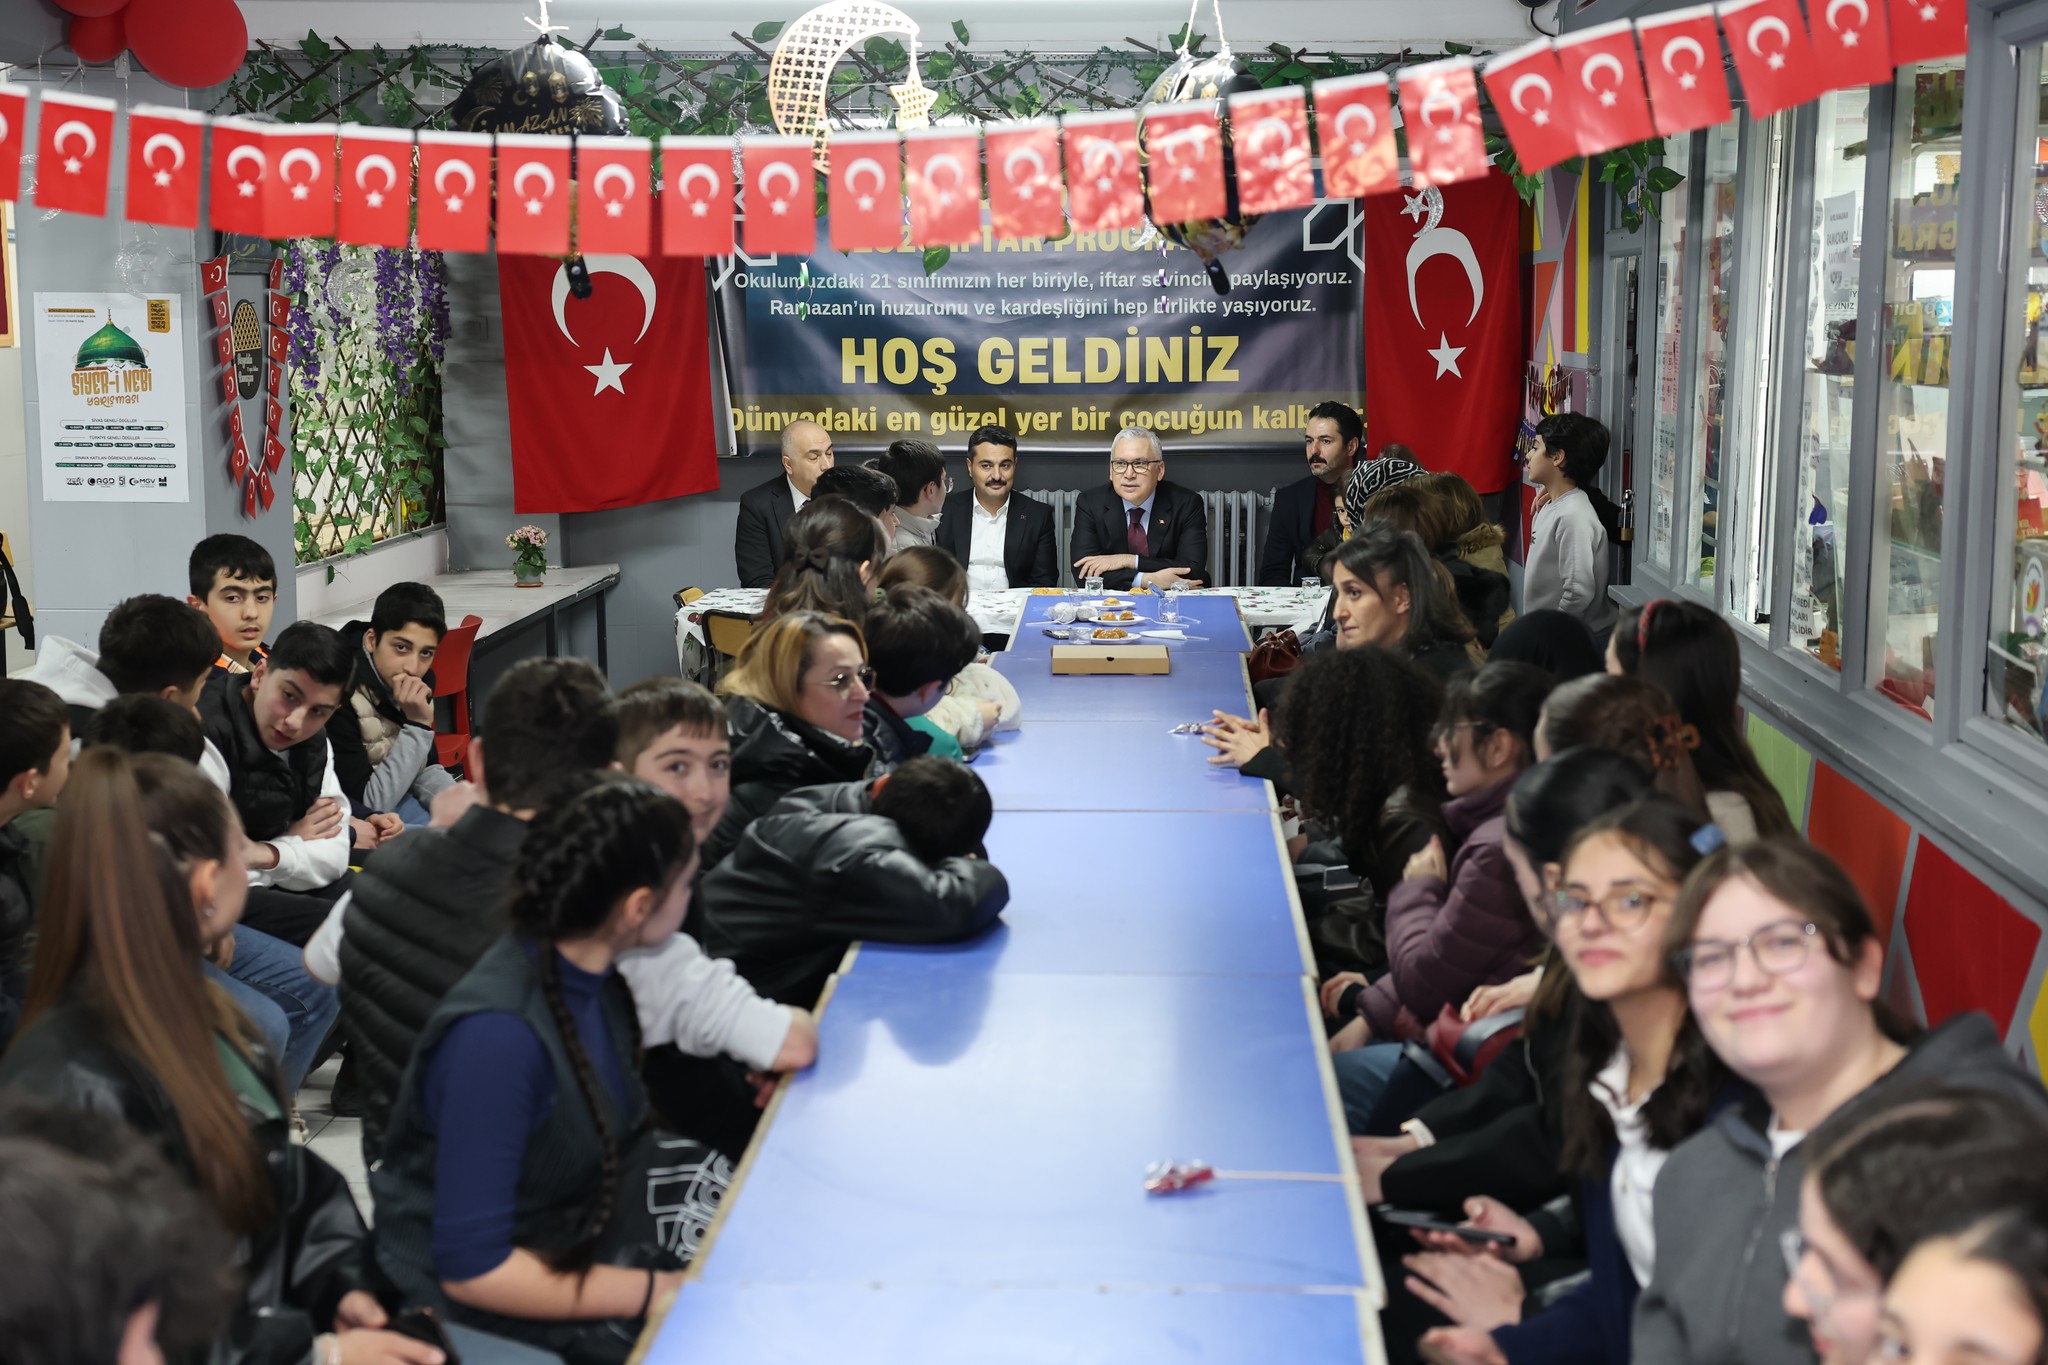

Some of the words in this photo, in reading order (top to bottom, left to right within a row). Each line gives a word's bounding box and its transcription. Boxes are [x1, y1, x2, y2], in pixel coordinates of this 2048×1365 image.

[481, 107, 568, 134] AMAZAN
[870, 273, 891, 289] 21
[997, 272, 1027, 288] her
[1032, 271, 1094, 292] biriyle,
[1099, 271, 1136, 288] iftar
[1230, 269, 1353, 290] paylaşıyoruz.
[881, 299, 968, 316] huzurunu
[974, 302, 996, 315] ve
[1001, 298, 1108, 319] kardeşliğini
[1113, 298, 1148, 318] hep
[1154, 297, 1217, 314] birlikte
[1222, 298, 1317, 318] yaşıyoruz.
[841, 337, 957, 396] HOŞ
[977, 325, 1240, 385] GELDİNİZ
[894, 411, 921, 431] en
[930, 406, 1006, 436] güzel
[1014, 412, 1062, 436] yer
[1071, 406, 1110, 431] bir
